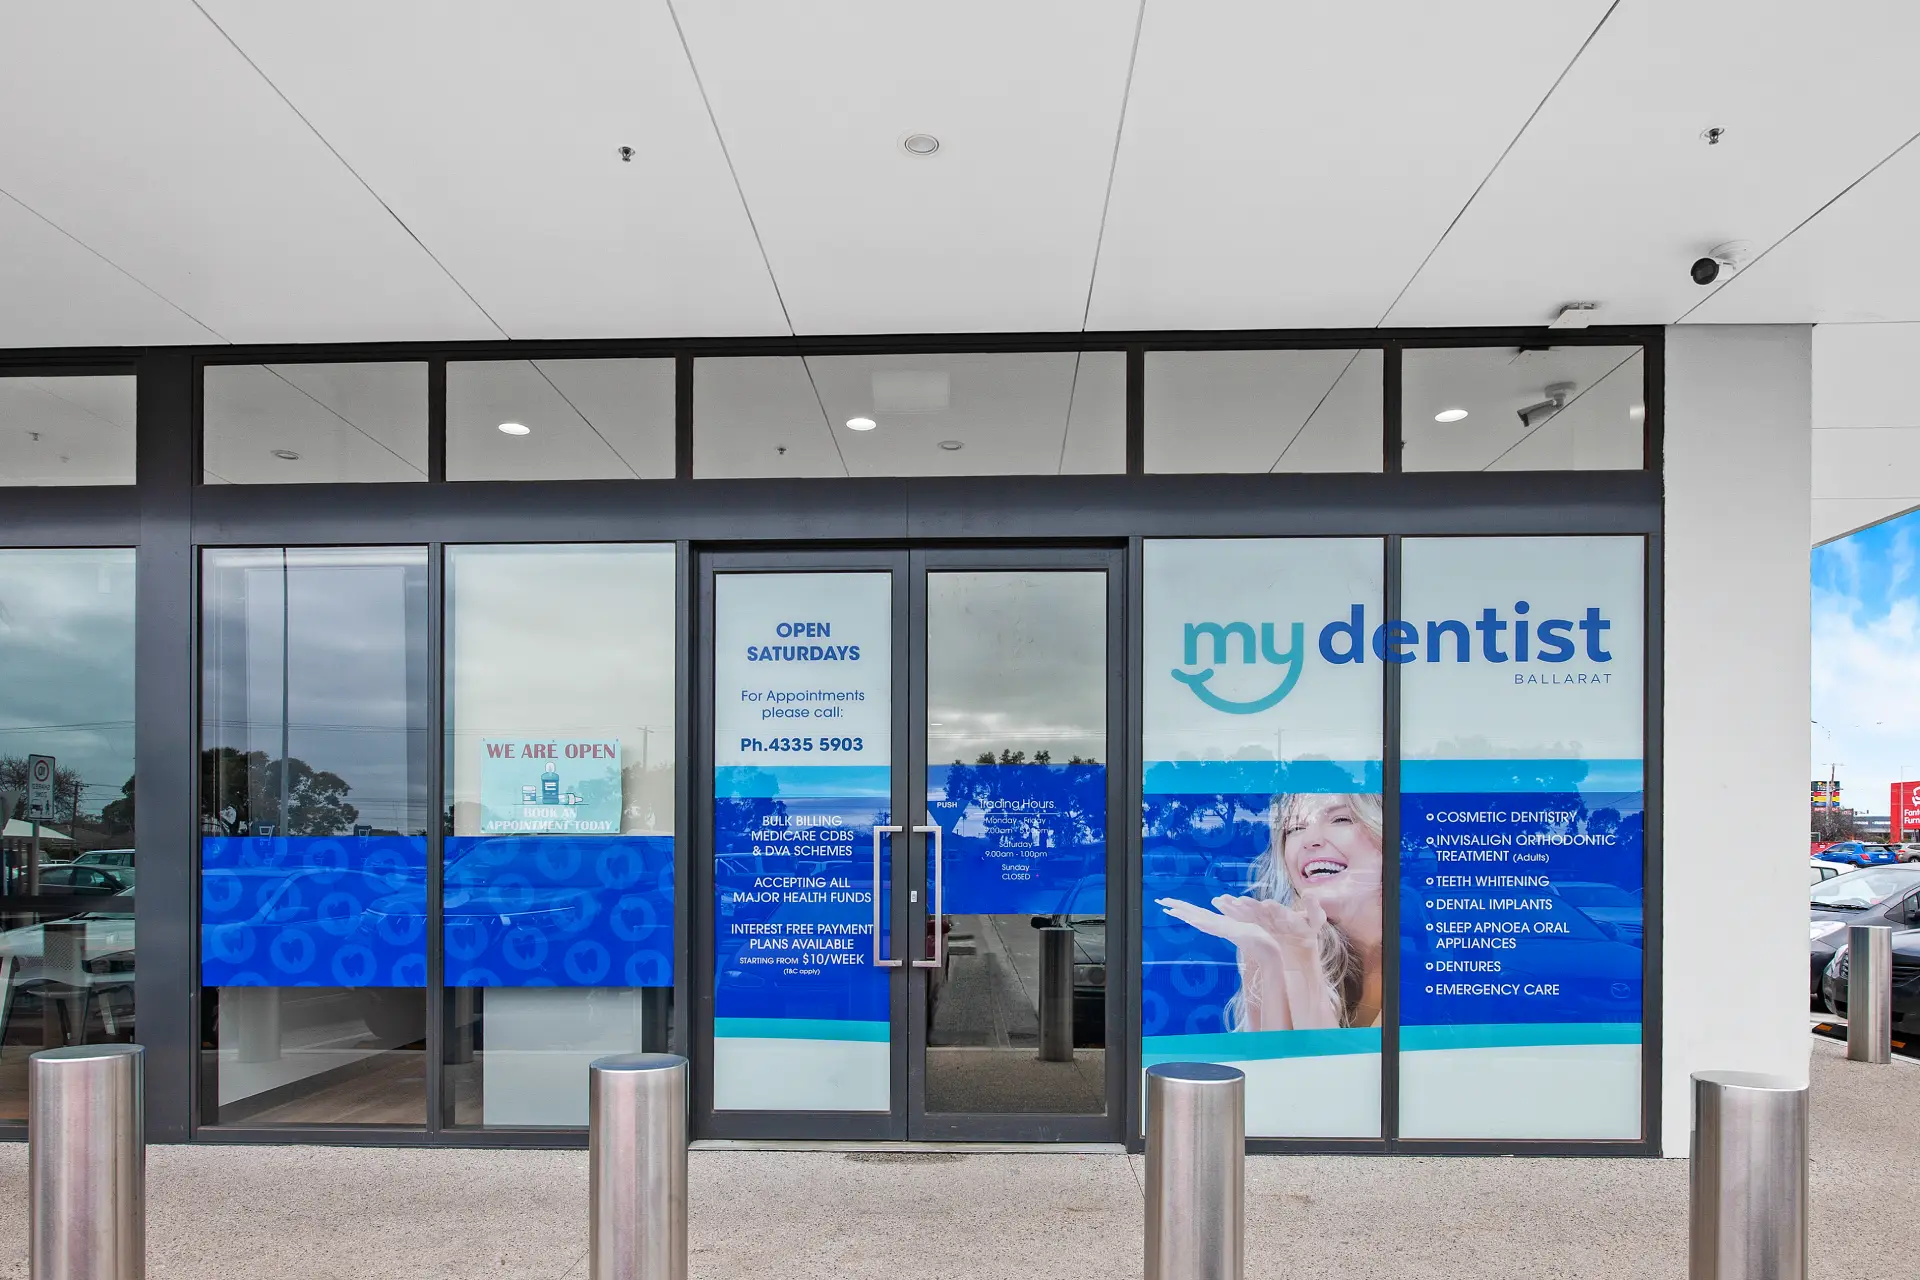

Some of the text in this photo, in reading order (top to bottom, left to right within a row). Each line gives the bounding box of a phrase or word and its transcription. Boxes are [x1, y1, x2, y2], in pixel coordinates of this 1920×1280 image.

[776, 622, 831, 638] OPEN
[747, 646, 860, 661] SATURDAYS
[1171, 600, 1613, 714] my dentist
[1514, 673, 1612, 684] BALLARAT
[741, 690, 865, 704] For Appointments
[762, 706, 843, 720] please call:
[740, 737, 864, 752] Ph.4335 5903
[487, 743, 616, 759] WE ARE OPEN
[979, 798, 1020, 811] Trading
[523, 807, 577, 819] BOOK AN
[1437, 811, 1577, 823] COSMETIC DENTISTRY
[487, 820, 613, 831] APPOINTMENT TODAY
[762, 815, 843, 827] BULK BILLING
[985, 817, 1046, 825] Monday Friday
[751, 830, 854, 842] MEDICARE CDBS
[1436, 834, 1616, 846] INVISALIGN ORTHODONTIC
[999, 840, 1033, 849] Saturday
[752, 845, 853, 857] & DVA SCHEMES
[985, 850, 1014, 858] 9.00am
[1020, 850, 1048, 859] 1.00pm
[1436, 850, 1549, 864] TREATMENT (Adults)
[754, 877, 851, 888] ACCEPTING ALL
[1436, 875, 1550, 887] TEETH WHITENING
[733, 892, 872, 903] MAJOR HEALTH FUNDS
[1436, 899, 1552, 910] DENTAL IMPLANTS
[731, 923, 874, 935] INTEREST FREE PAYMENT
[1436, 922, 1570, 933] SLEEP APNOEA ORAL
[750, 939, 854, 950] PLANS AVAILABLE
[1436, 937, 1516, 949] APPLIANCES
[739, 953, 865, 966] STARTING FROM $10/WEEK
[799, 968, 821, 976] apply)
[1436, 961, 1501, 972] DENTURES
[1436, 984, 1559, 996] EMERGENCY CARE
